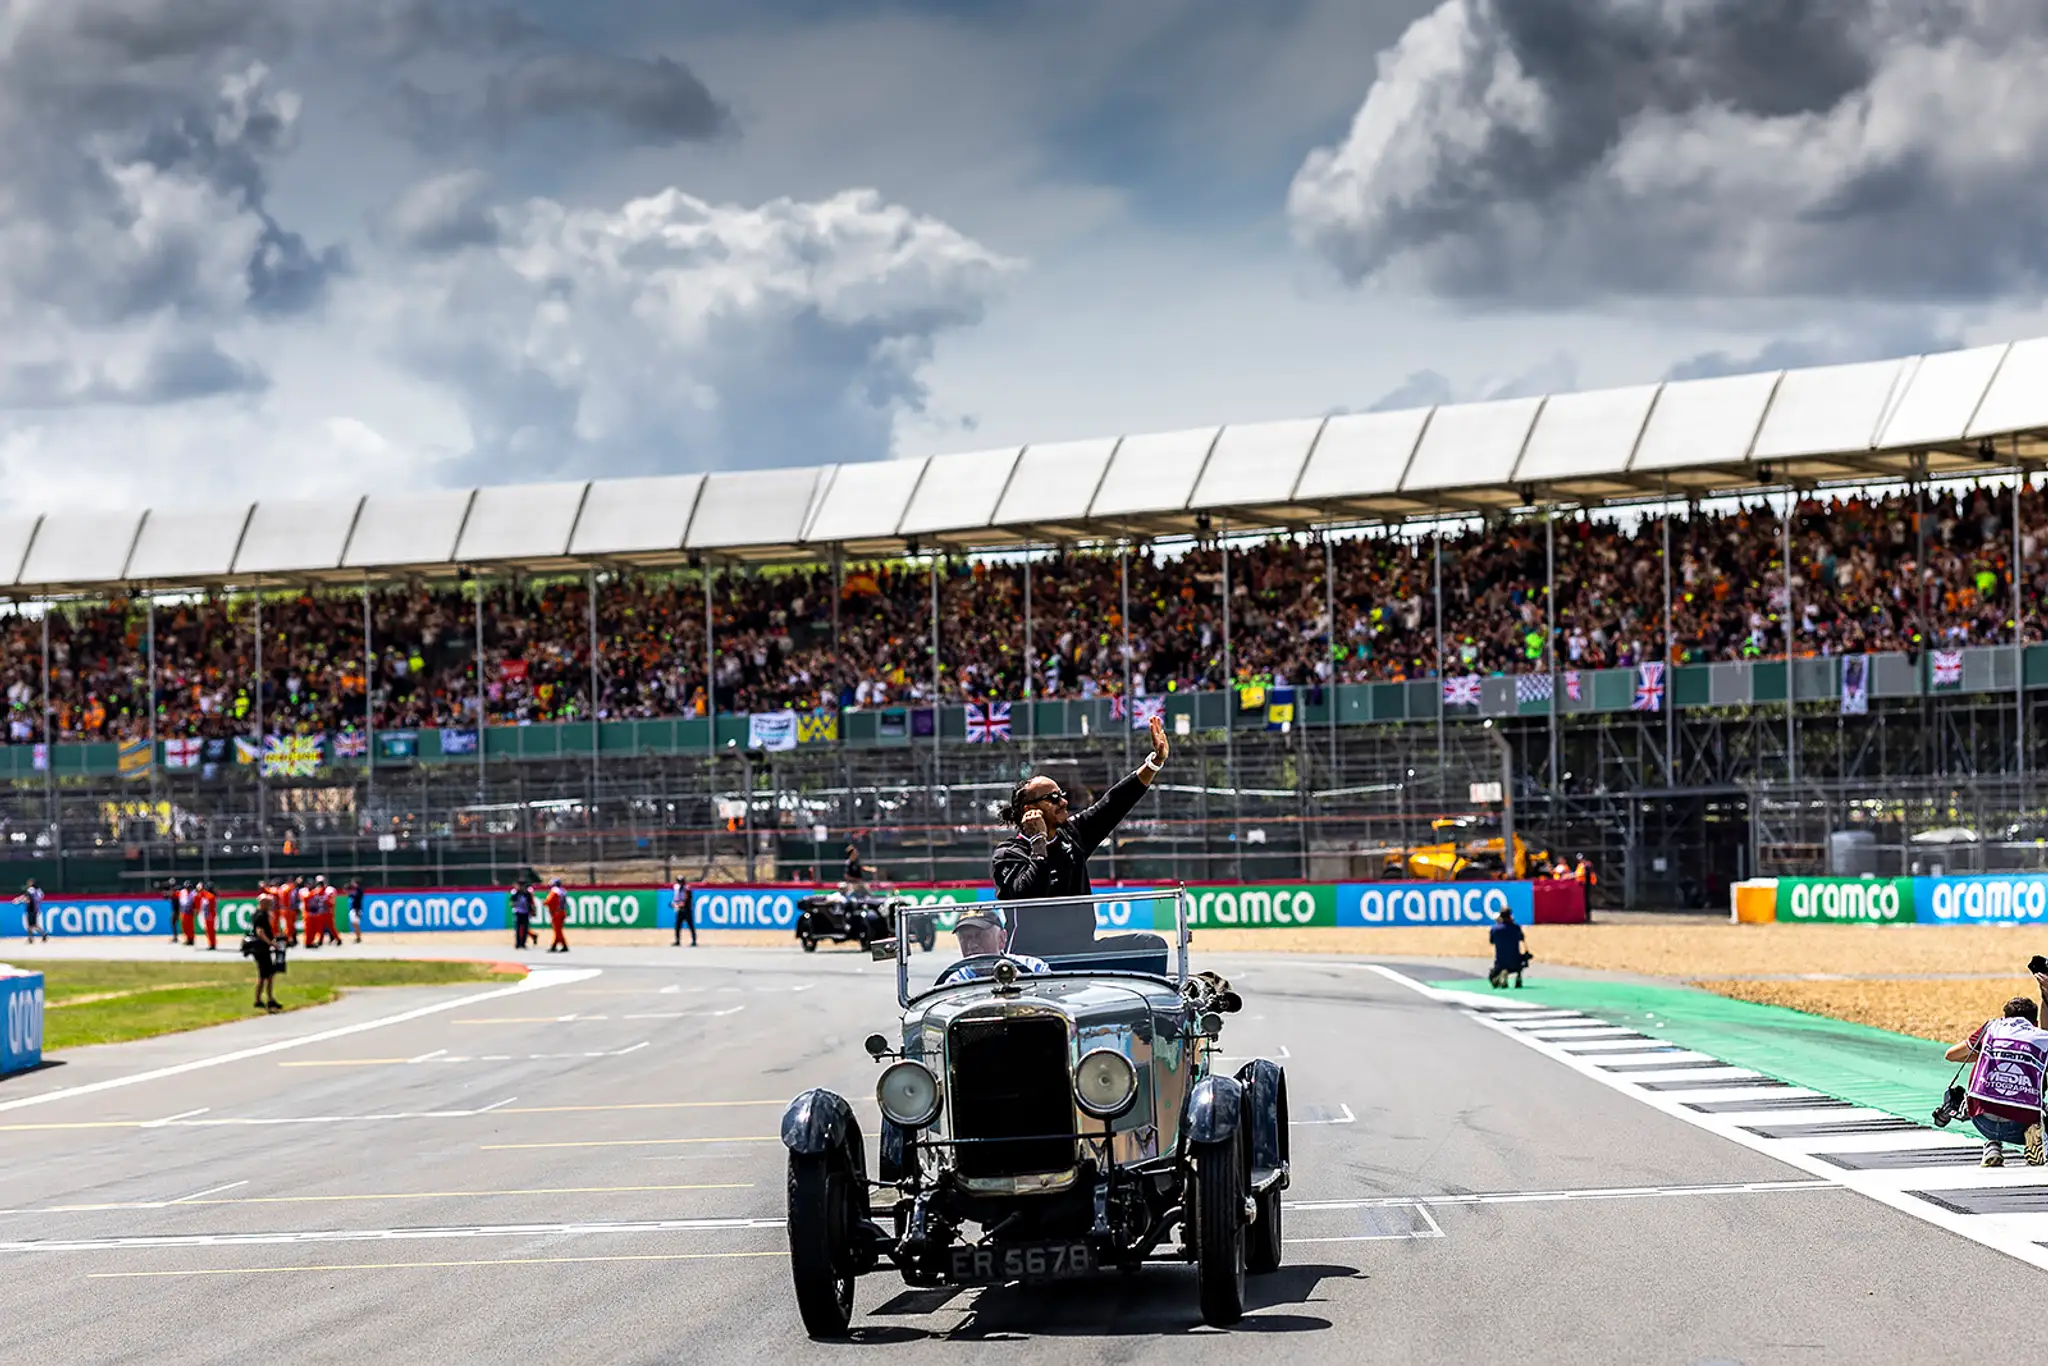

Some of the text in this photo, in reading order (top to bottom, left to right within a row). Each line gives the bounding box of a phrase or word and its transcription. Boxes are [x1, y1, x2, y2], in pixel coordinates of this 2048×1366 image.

[368, 897, 488, 927] aramco
[696, 894, 794, 925] ramco
[1360, 888, 1508, 922] aramco
[1790, 883, 1899, 919] aramco
[1931, 881, 2046, 919] aramco
[1987, 1070, 2033, 1087] MEDIA
[952, 1244, 1089, 1277] ER 5678
